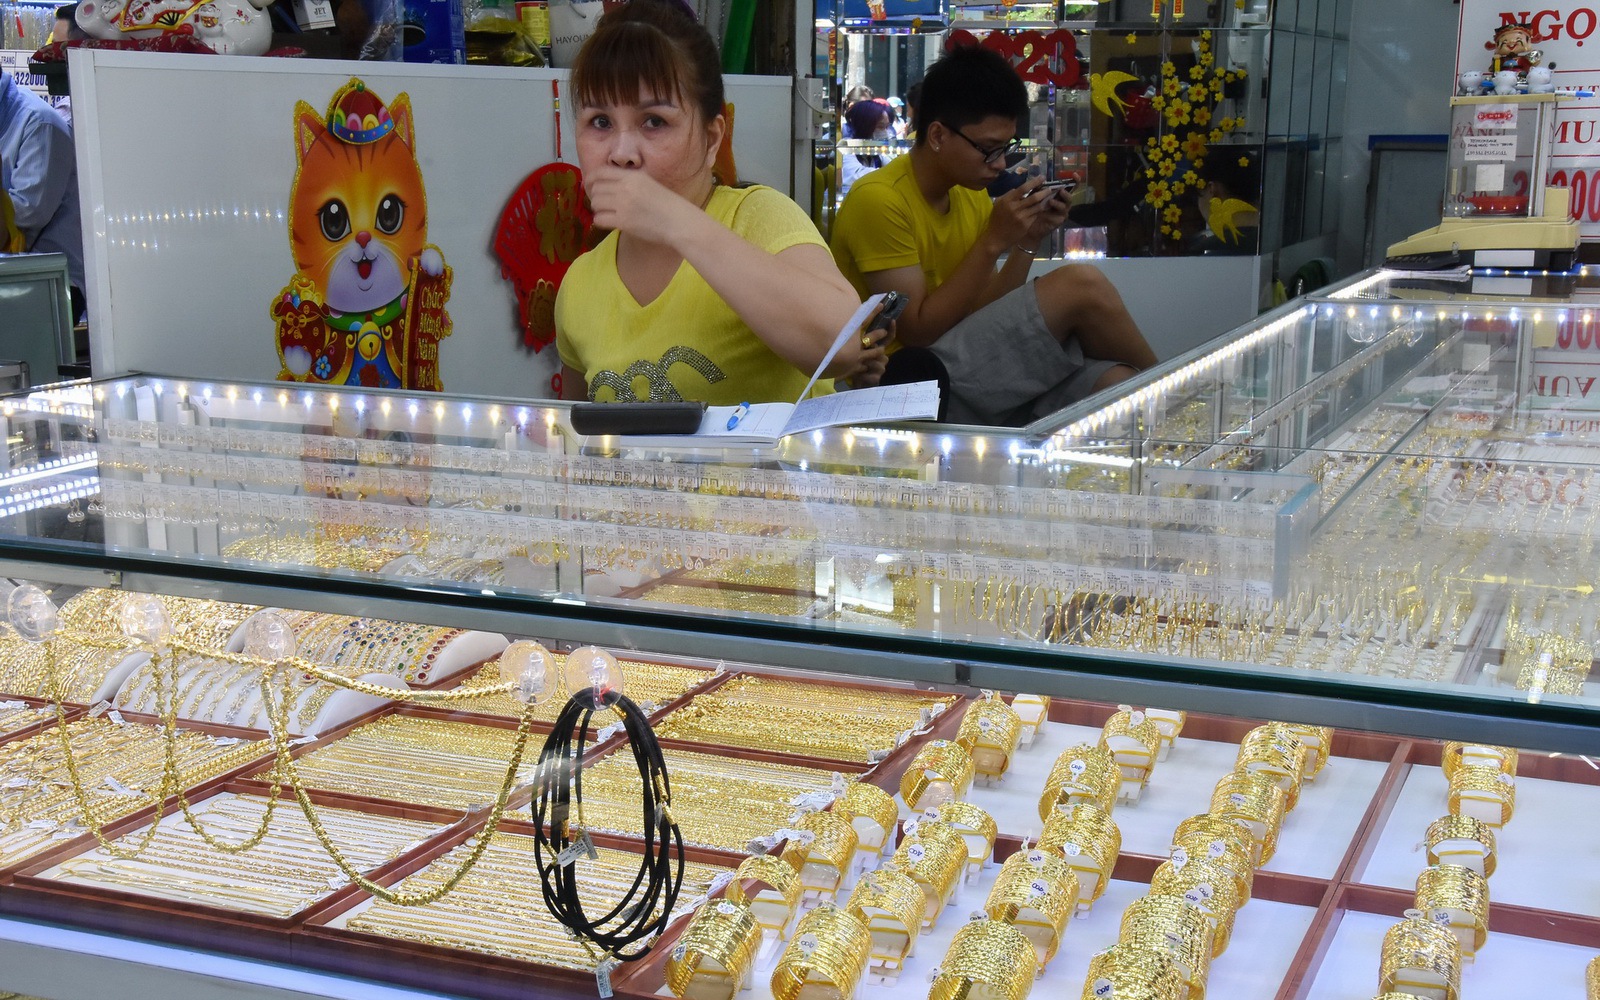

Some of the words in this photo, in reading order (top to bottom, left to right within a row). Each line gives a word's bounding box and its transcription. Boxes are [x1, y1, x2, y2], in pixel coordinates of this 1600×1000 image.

[314, 7, 327, 15] JET
[1549, 120, 1600, 144] MU
[421, 284, 443, 309] Chúc
